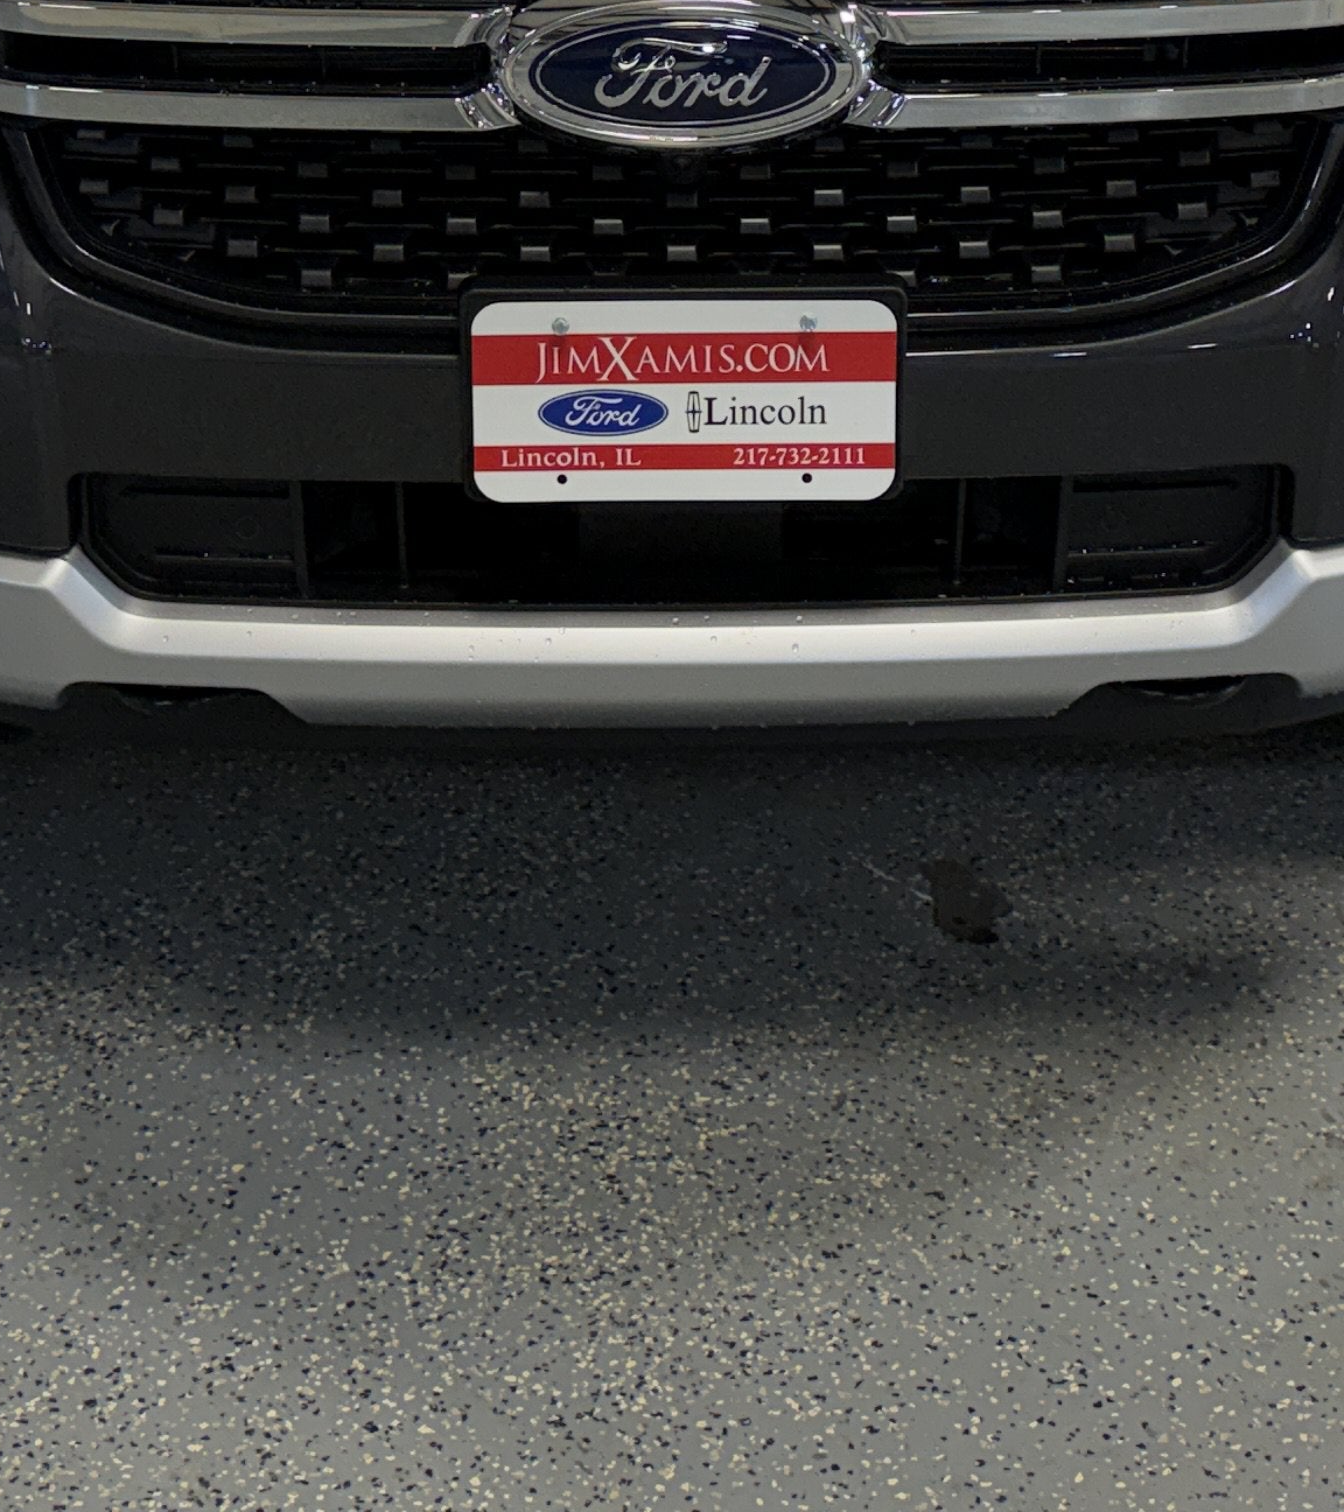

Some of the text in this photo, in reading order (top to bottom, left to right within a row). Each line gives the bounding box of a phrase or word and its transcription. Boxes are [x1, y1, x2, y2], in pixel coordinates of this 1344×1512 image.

[594, 37, 775, 108] Ford
[536, 336, 830, 383] JIMXAMIS.COM
[565, 398, 640, 427] Ford
[704, 397, 825, 425] Lincoln
[501, 448, 641, 468] Lincoln, IL
[734, 448, 864, 465] 217-732-2111
